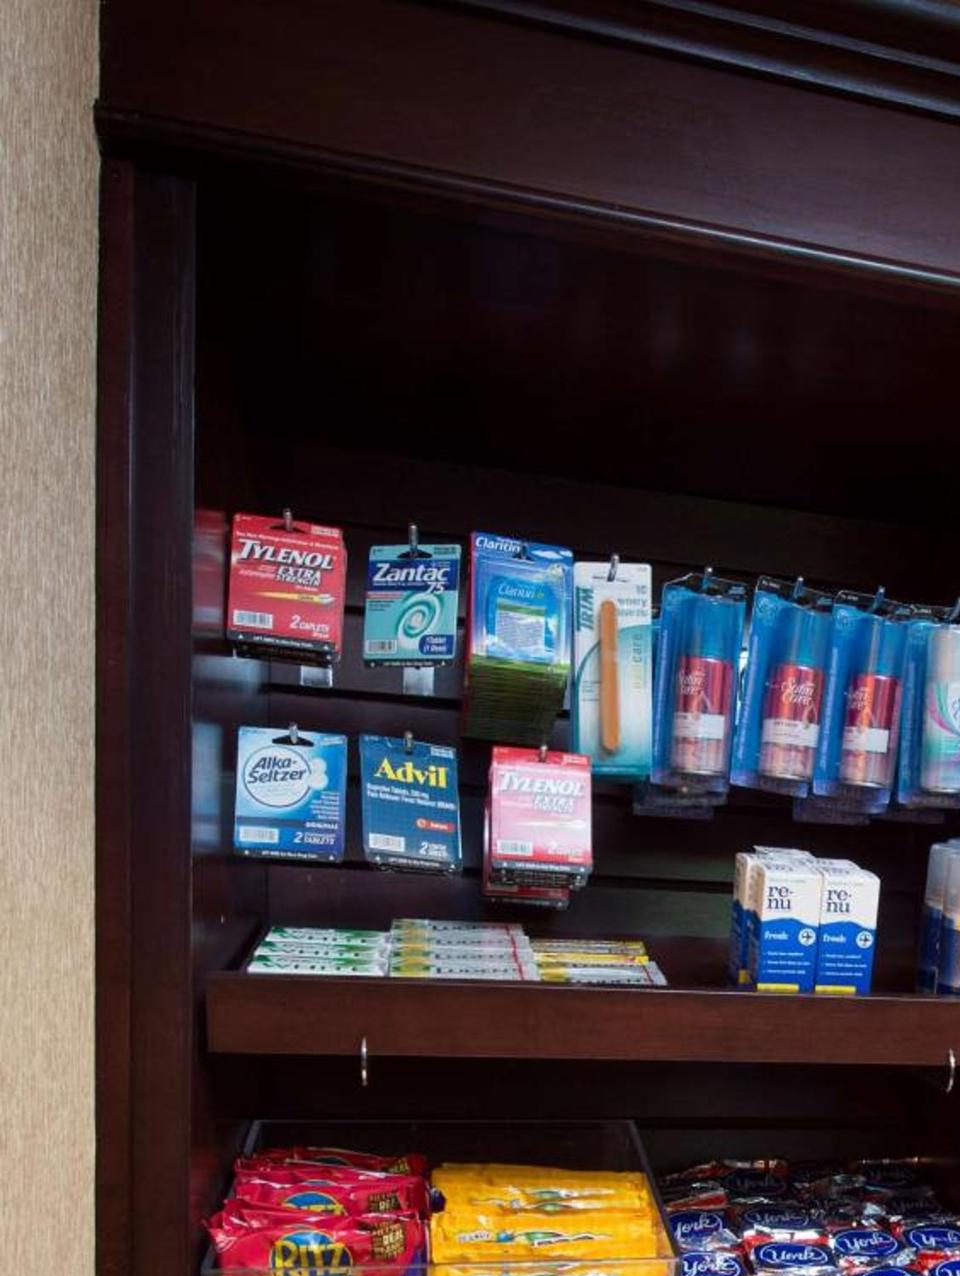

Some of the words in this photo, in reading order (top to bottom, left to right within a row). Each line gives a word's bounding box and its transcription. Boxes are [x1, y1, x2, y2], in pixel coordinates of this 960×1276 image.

[475, 535, 521, 554] Claritin
[238, 538, 333, 571] TYLENOL
[373, 562, 451, 582] Zantac
[425, 581, 449, 595] 75
[576, 586, 594, 631] TRIM
[290, 614, 301, 629] 2
[253, 755, 299, 772] Alka-
[373, 756, 450, 788] Advil
[247, 768, 309, 786] Seltzer
[500, 771, 586, 797] TYLENOL
[293, 831, 303, 843] 2
[419, 841, 429, 856] 2
[767, 898, 791, 910] nu
[827, 901, 850, 913] nu
[845, 1231, 888, 1249] York
[768, 1245, 817, 1261] York
